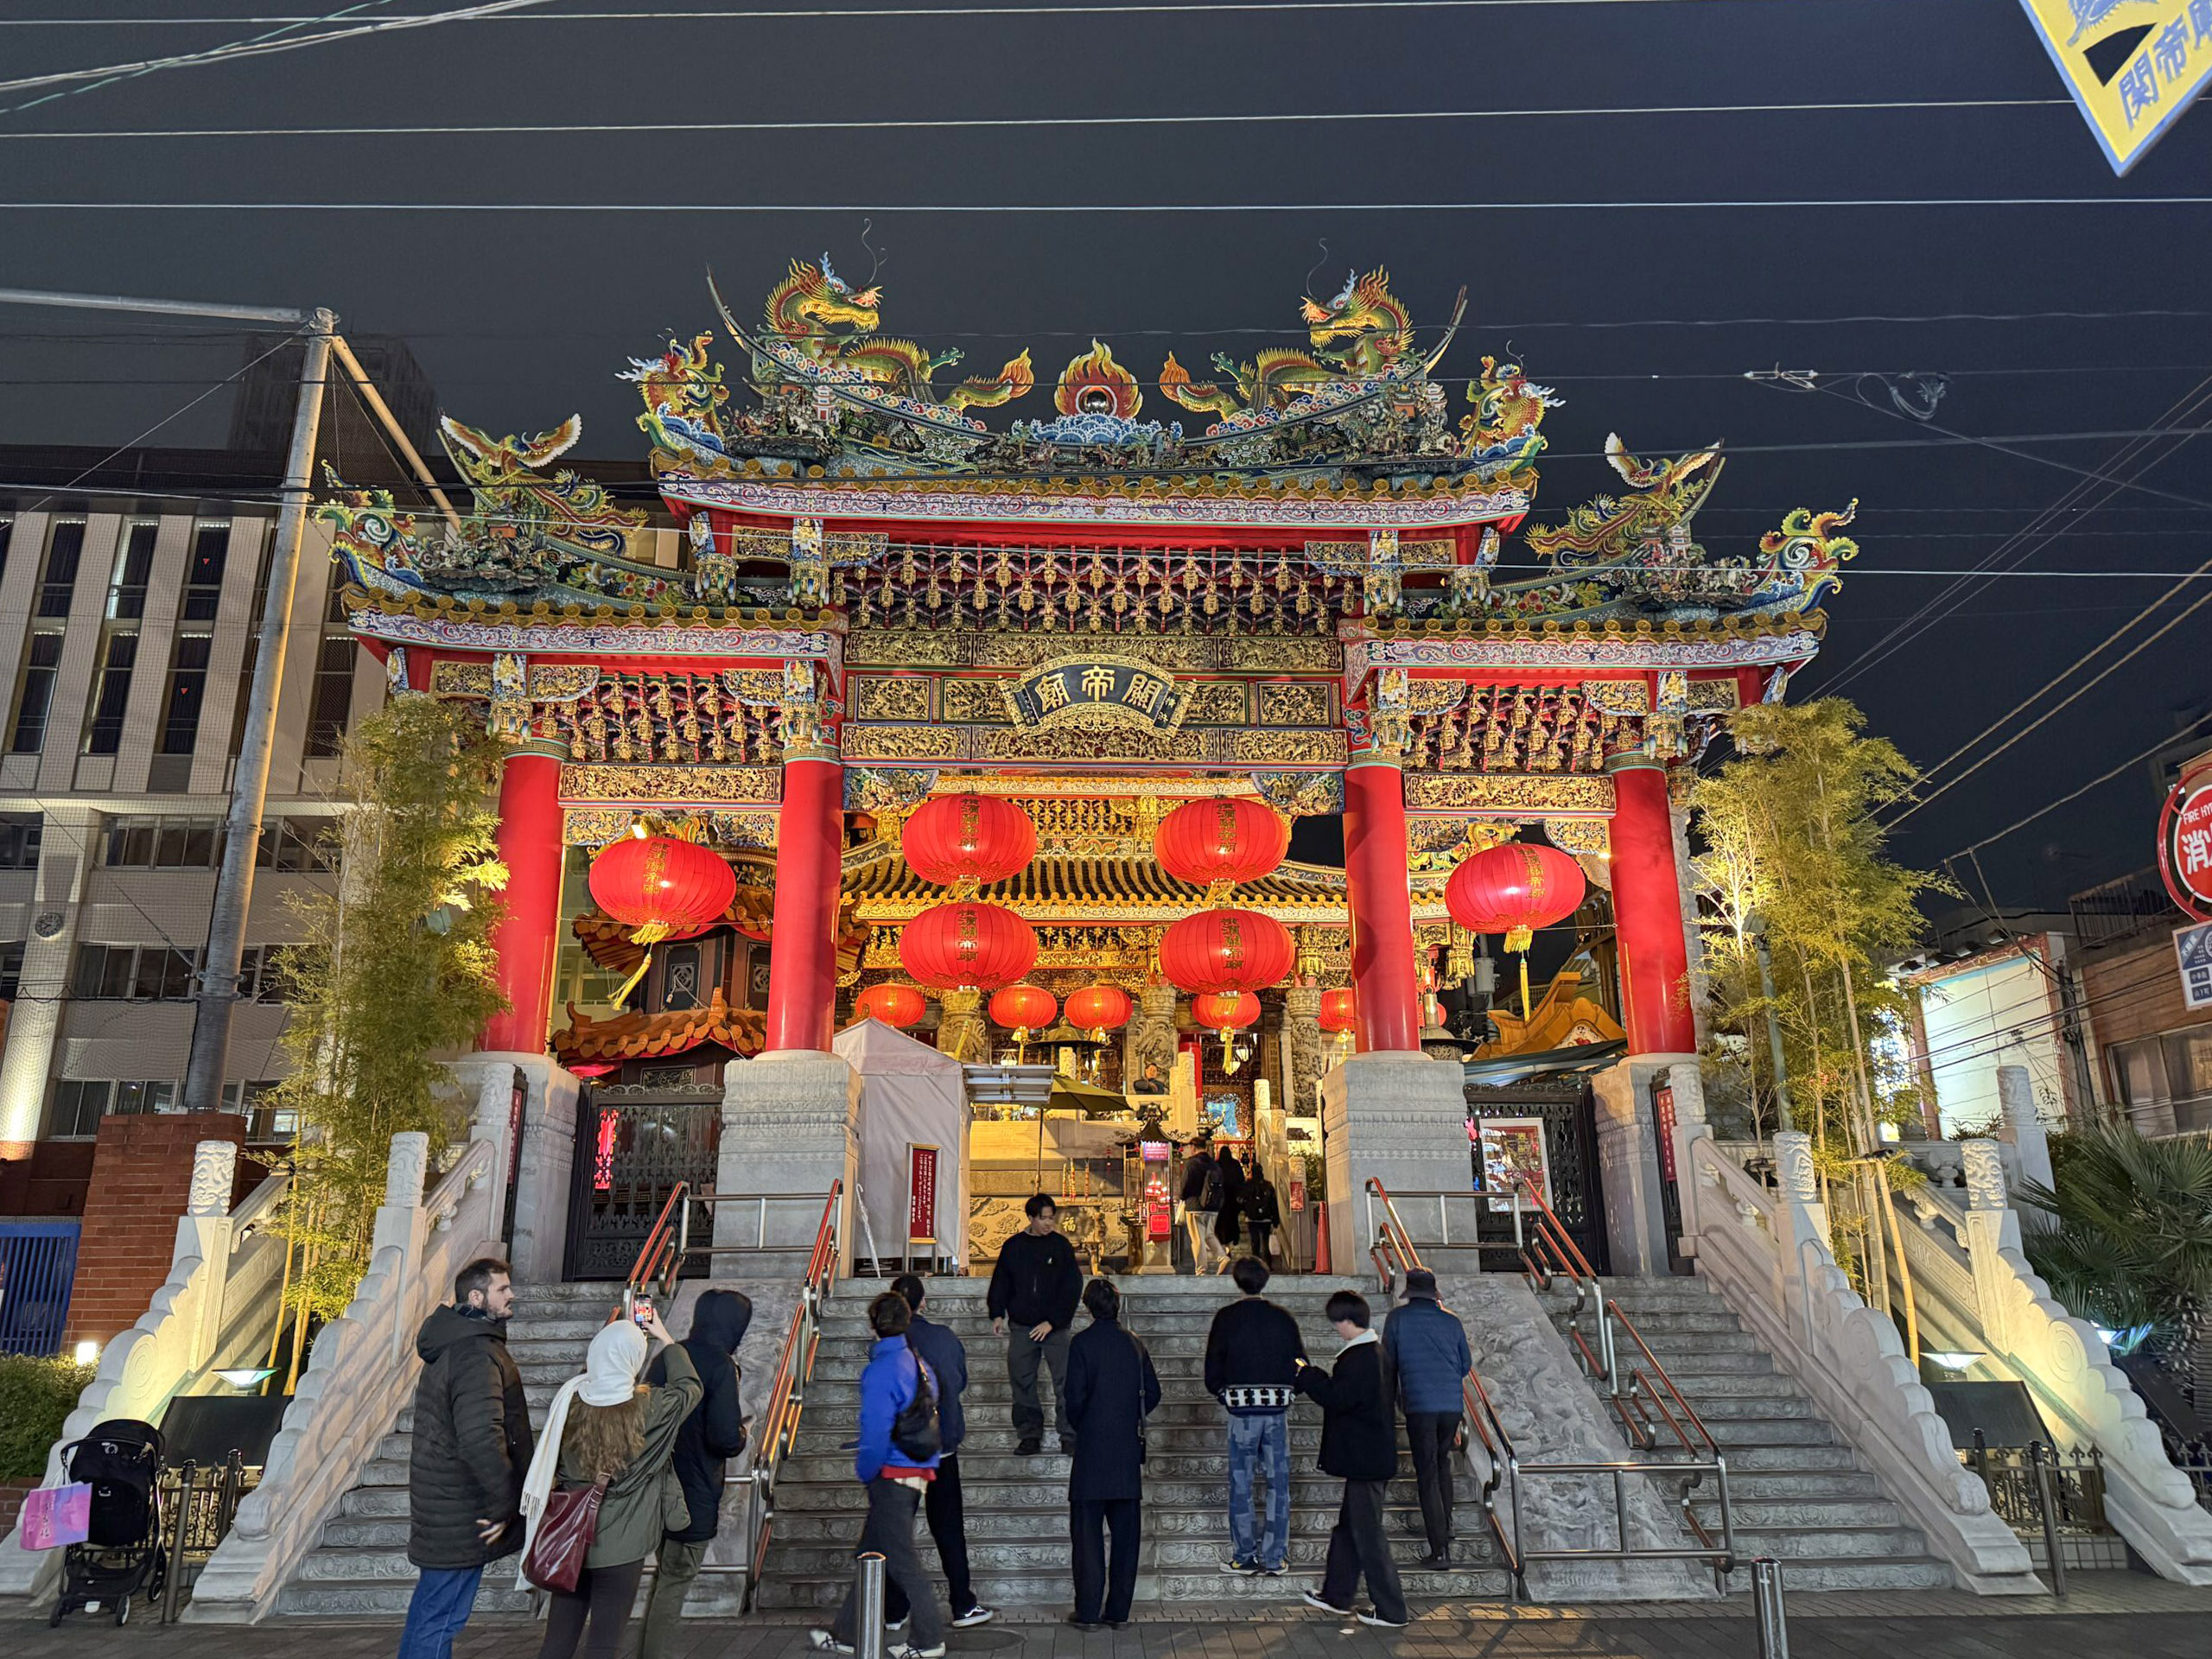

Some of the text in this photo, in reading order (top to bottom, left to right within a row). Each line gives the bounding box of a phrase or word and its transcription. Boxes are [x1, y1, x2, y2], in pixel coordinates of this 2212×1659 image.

[2183, 808, 2201, 825] FIRE
[2180, 822, 2212, 874] 消
[1062, 1216, 1076, 1232] 福
